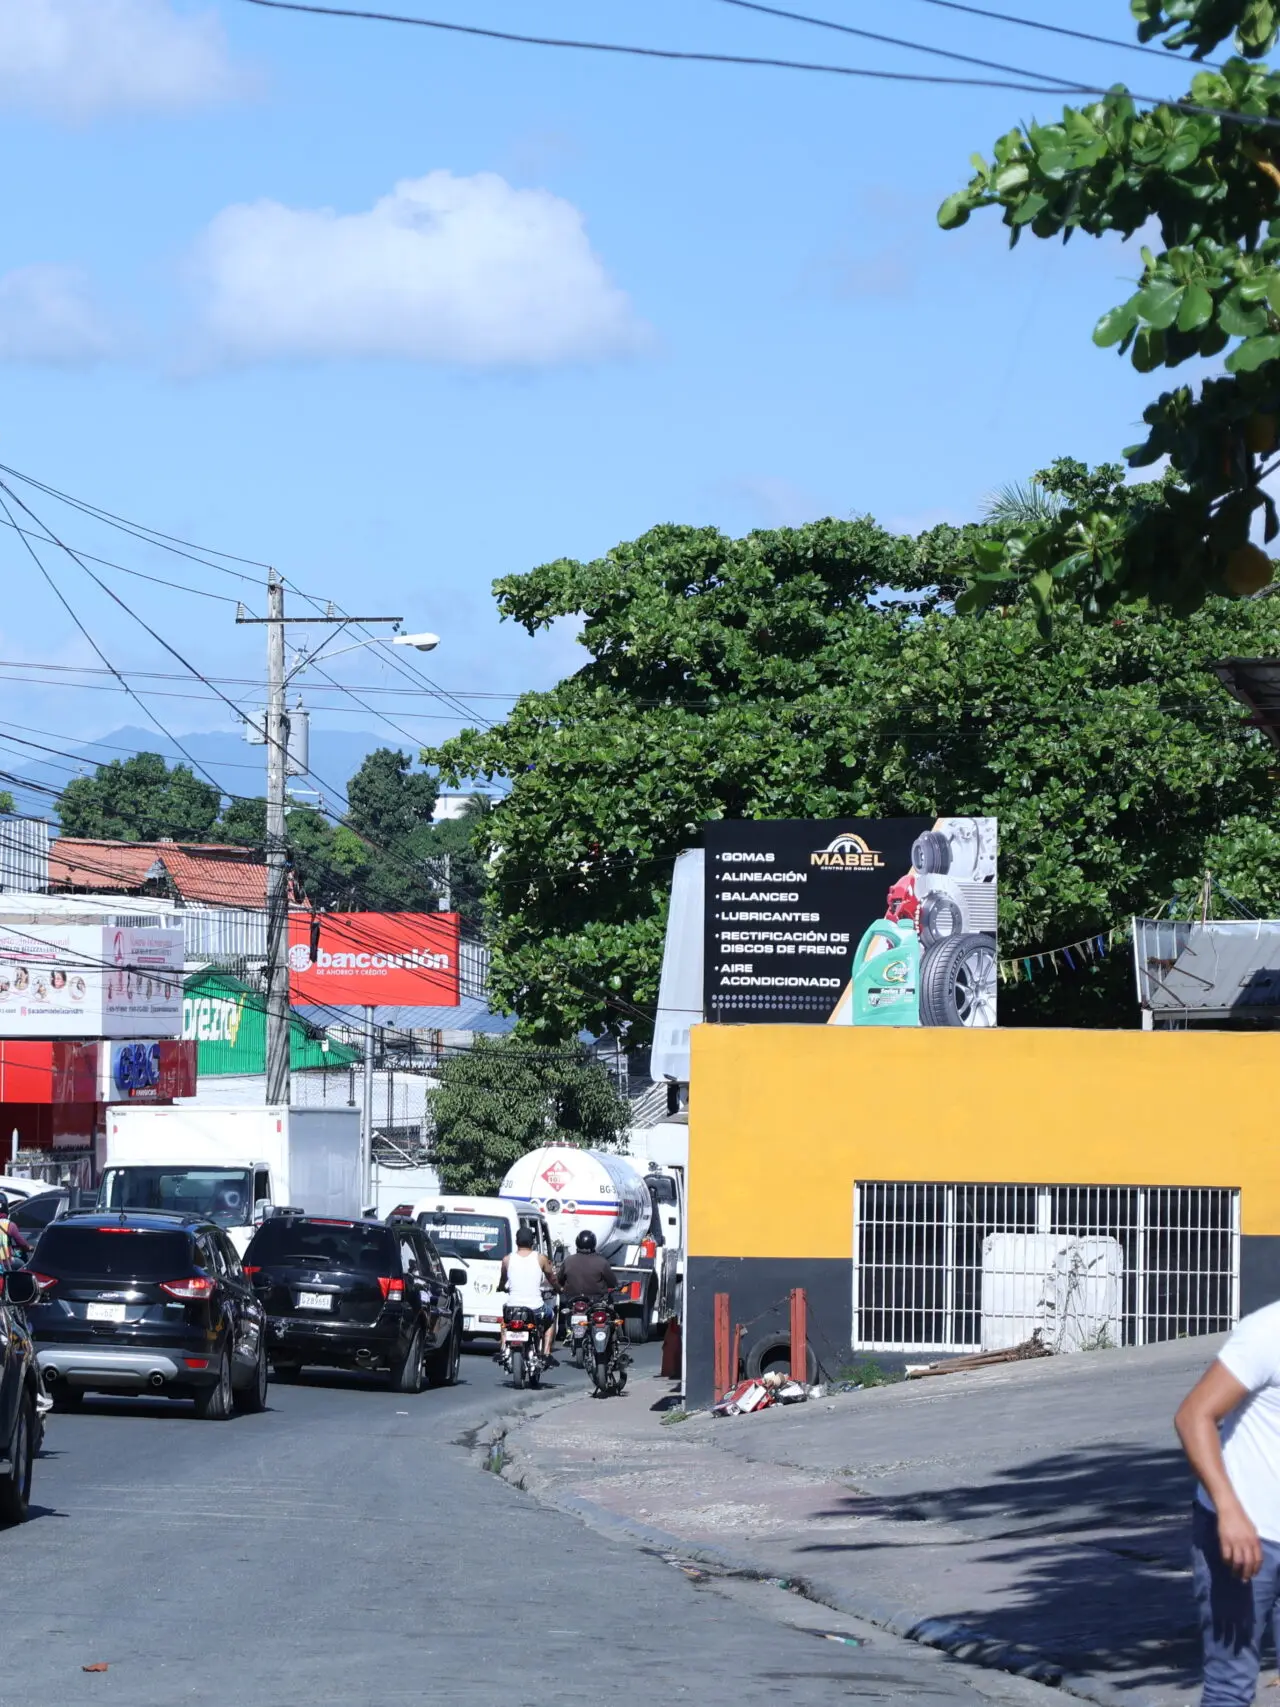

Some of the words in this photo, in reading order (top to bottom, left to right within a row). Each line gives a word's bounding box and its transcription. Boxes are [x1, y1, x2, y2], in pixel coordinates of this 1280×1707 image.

[721, 852, 776, 862] GOMAS
[810, 853, 885, 866] MABEL
[721, 870, 807, 883] ALINEACIÓN
[721, 891, 799, 902] BALANCEO
[721, 911, 820, 922] LUBRICANTES
[721, 931, 828, 942] RECTIFICACIÓN
[830, 932, 850, 943] DE
[721, 944, 774, 954] DISCOS
[776, 945, 795, 954] DE
[798, 945, 847, 955] FRENO
[720, 963, 753, 973] AIRE
[720, 976, 840, 988] ACONDICIONADO
[599, 1185, 617, 1194] BG-3
